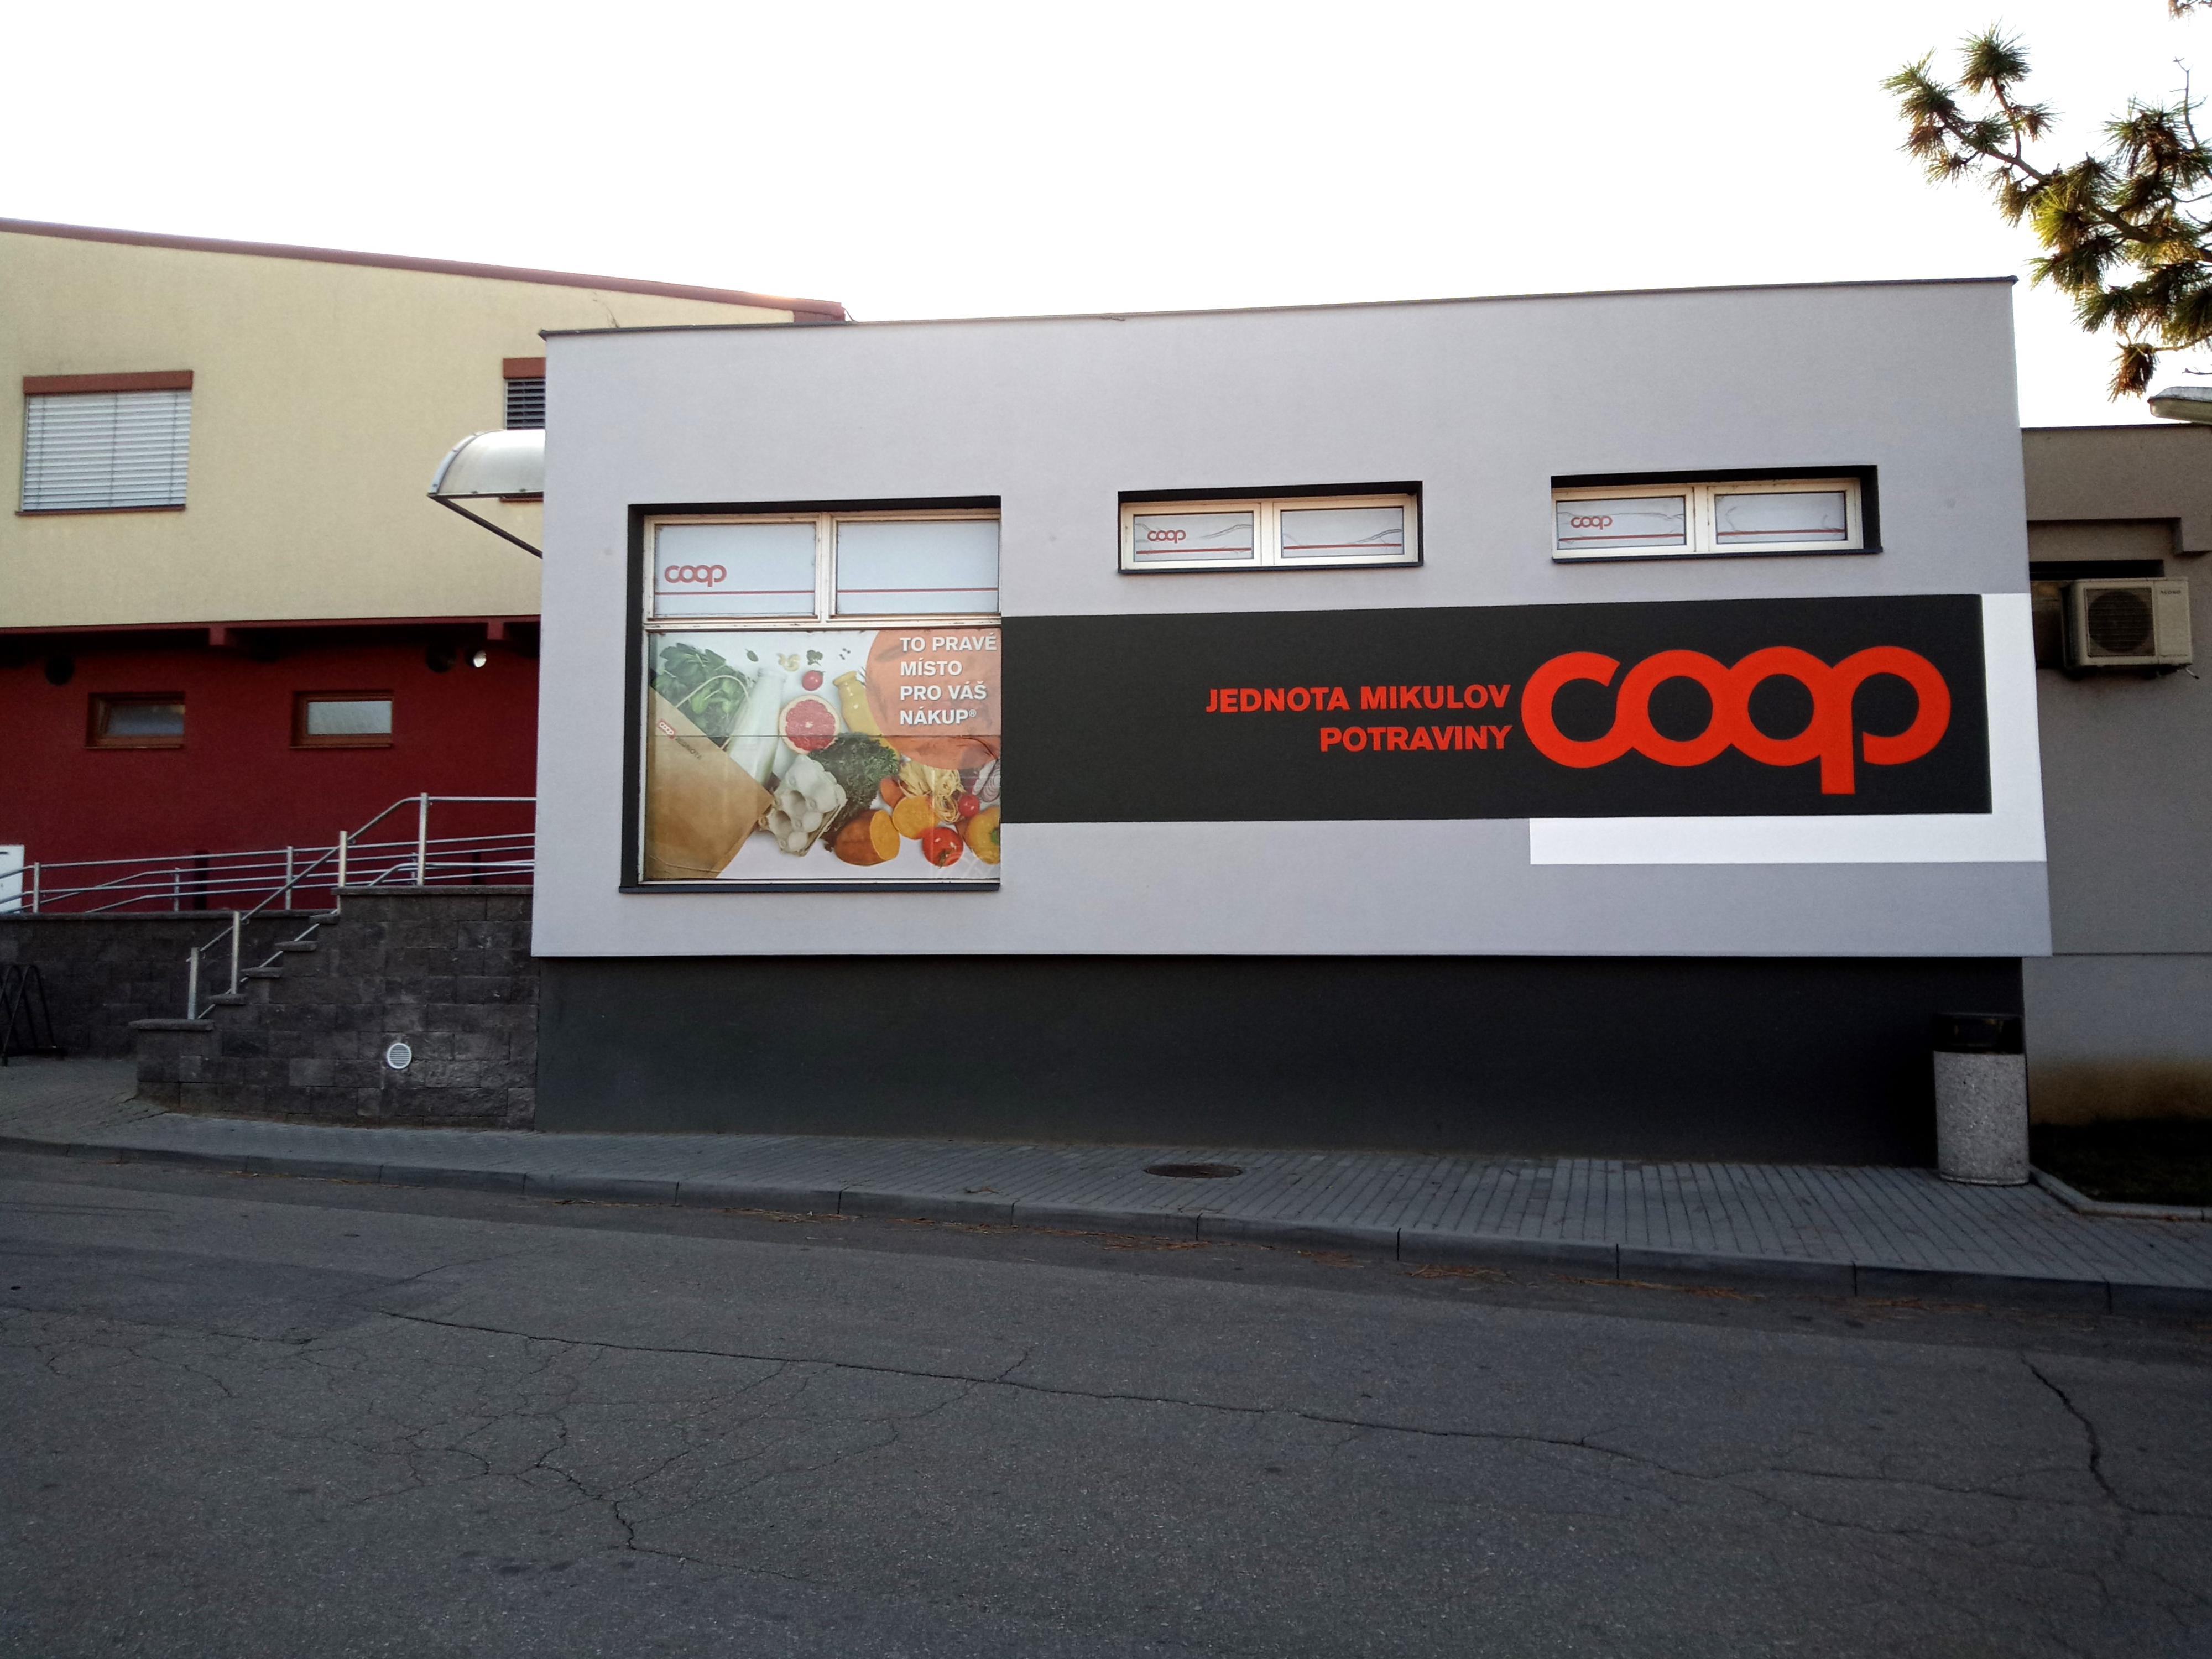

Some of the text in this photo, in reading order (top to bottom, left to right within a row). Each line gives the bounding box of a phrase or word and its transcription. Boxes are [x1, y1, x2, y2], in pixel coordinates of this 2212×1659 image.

[1571, 515, 1613, 530] coop
[1147, 529, 1186, 544] coop
[665, 564, 727, 587] coop
[900, 632, 997, 652] TO PRAVÉ
[900, 657, 963, 676] MÍSTO
[900, 681, 987, 701] PRO VÁŠ
[1205, 684, 1512, 714] JEDNOTA MIKULOV
[1520, 645, 1952, 796] coop
[1319, 725, 1513, 753] POTRAVINY
